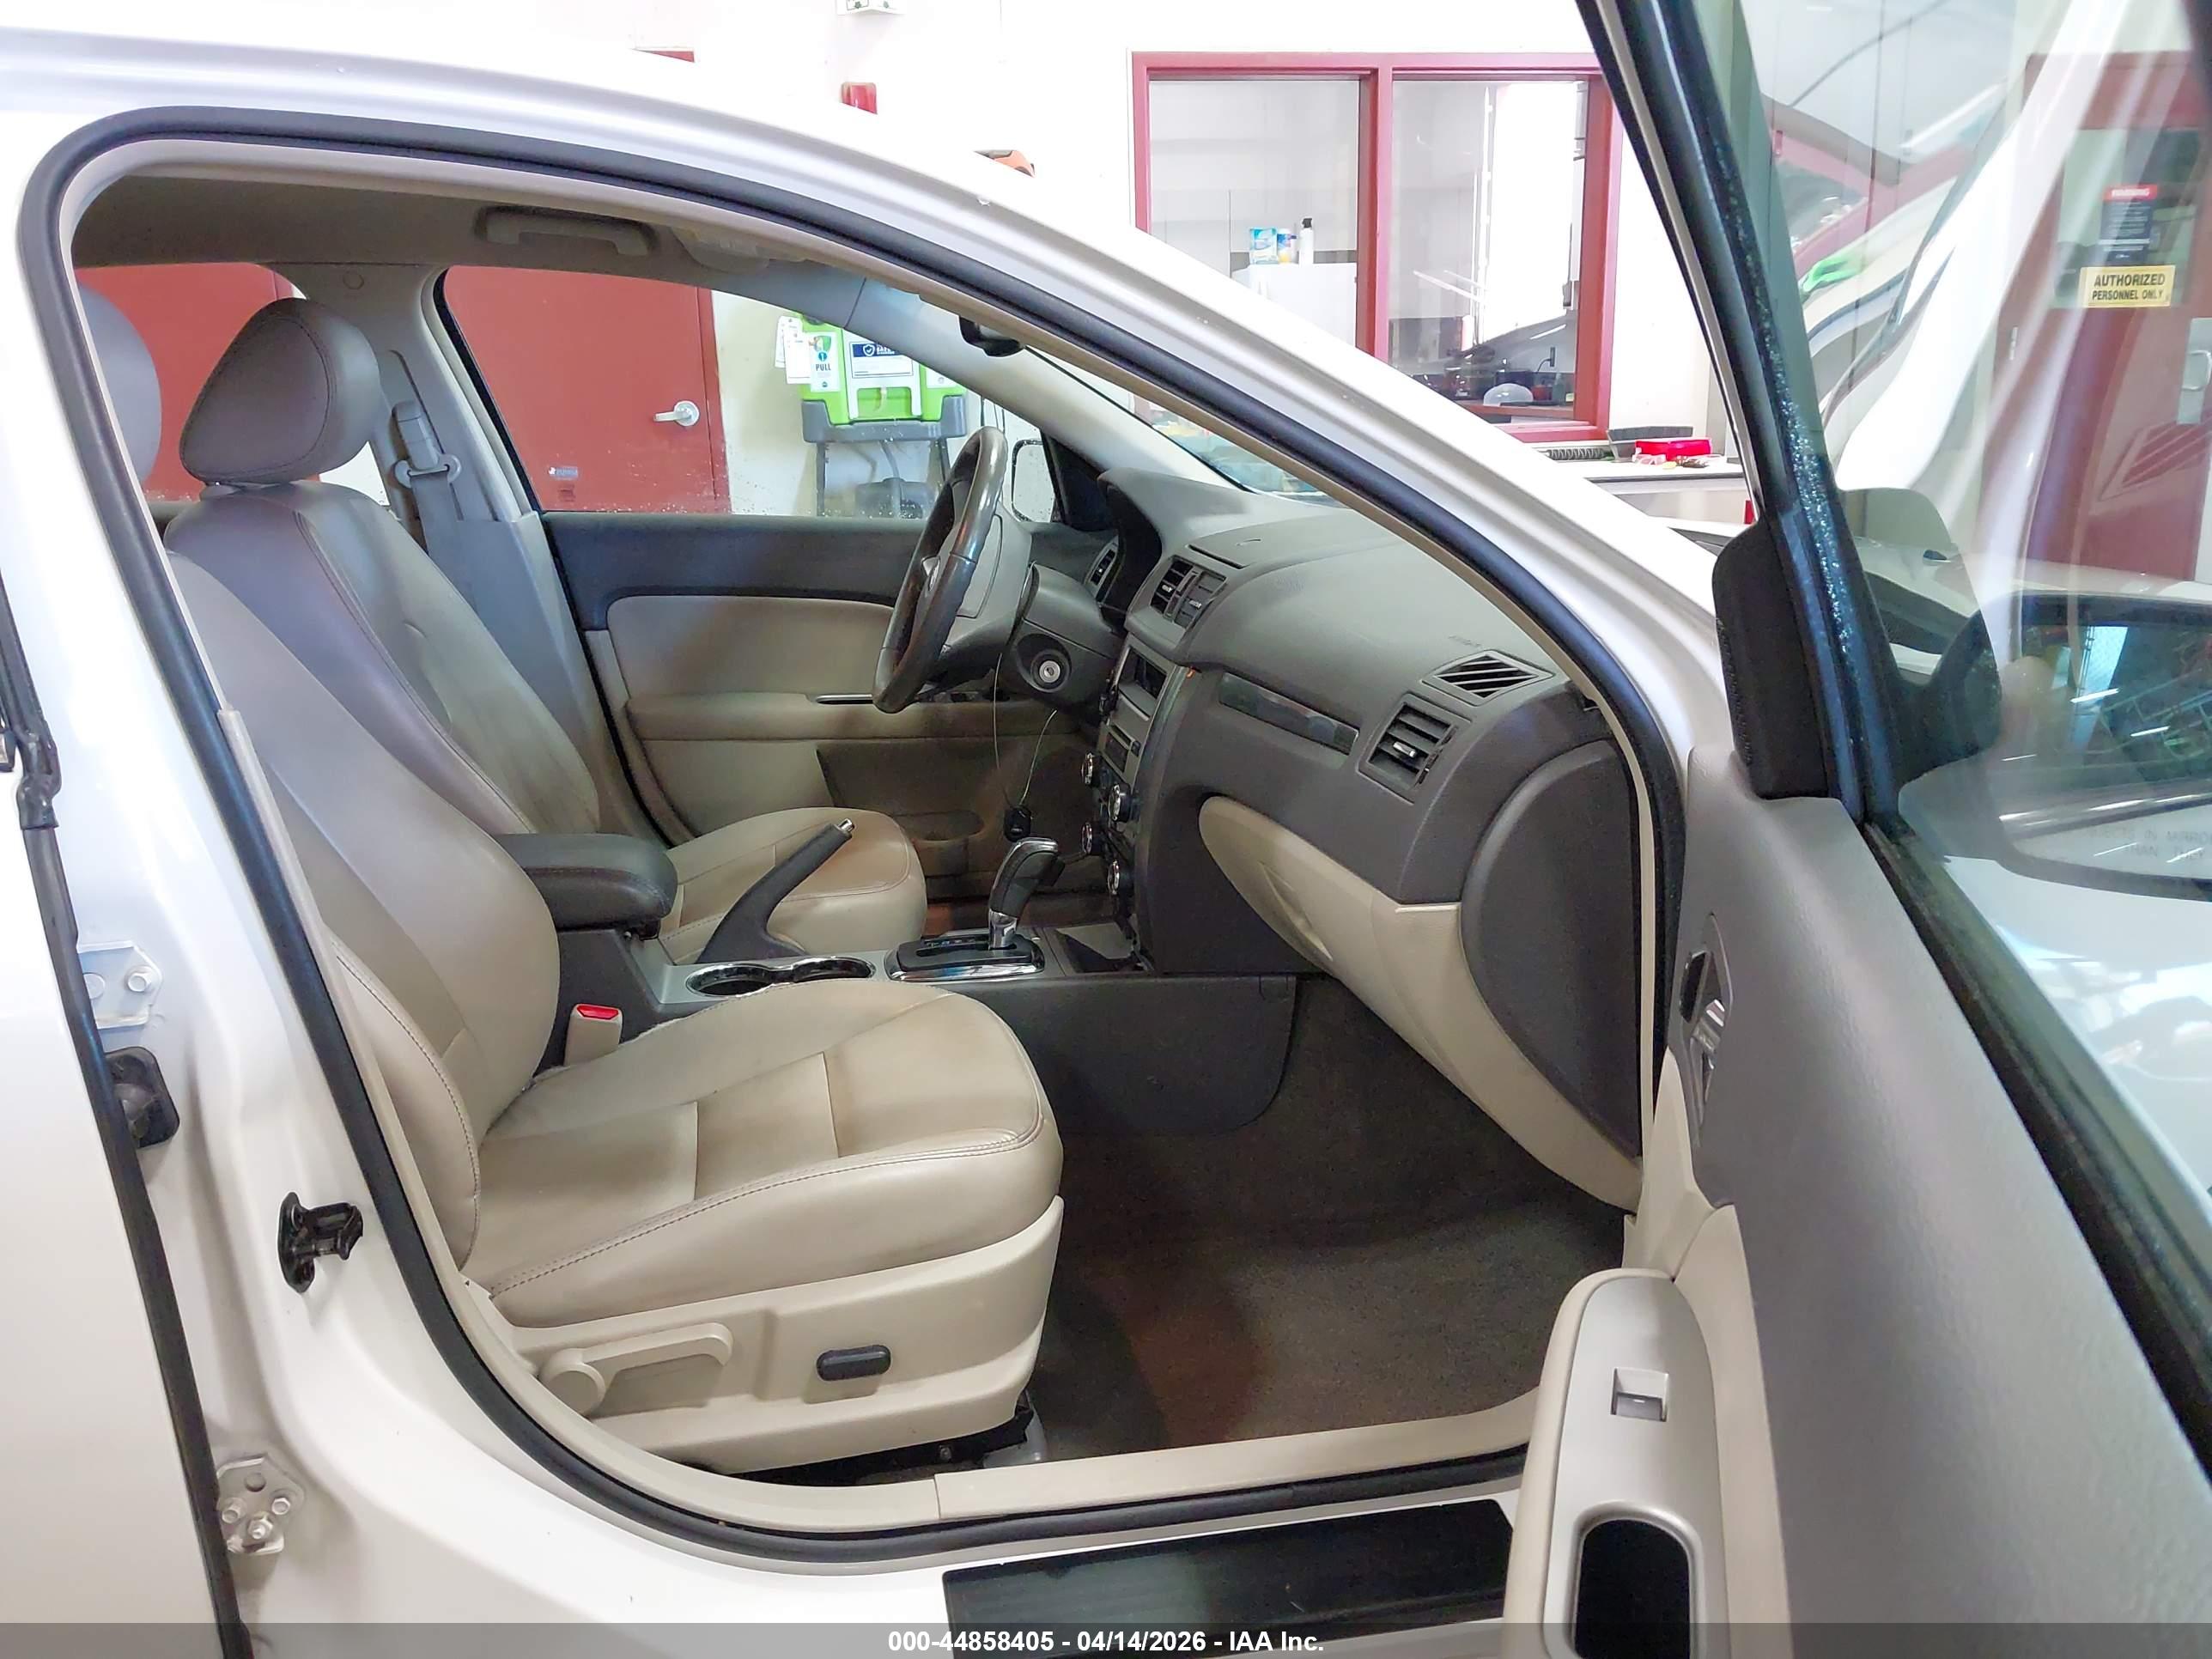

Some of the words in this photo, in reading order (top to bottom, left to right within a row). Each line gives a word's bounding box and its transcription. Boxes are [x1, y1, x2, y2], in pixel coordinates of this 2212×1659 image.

[2094, 274, 2166, 288] AUTHORIZED
[2093, 290, 2138, 301] PERSONNEL
[2142, 289, 2163, 300] ONLY
[816, 363, 832, 372] PULL
